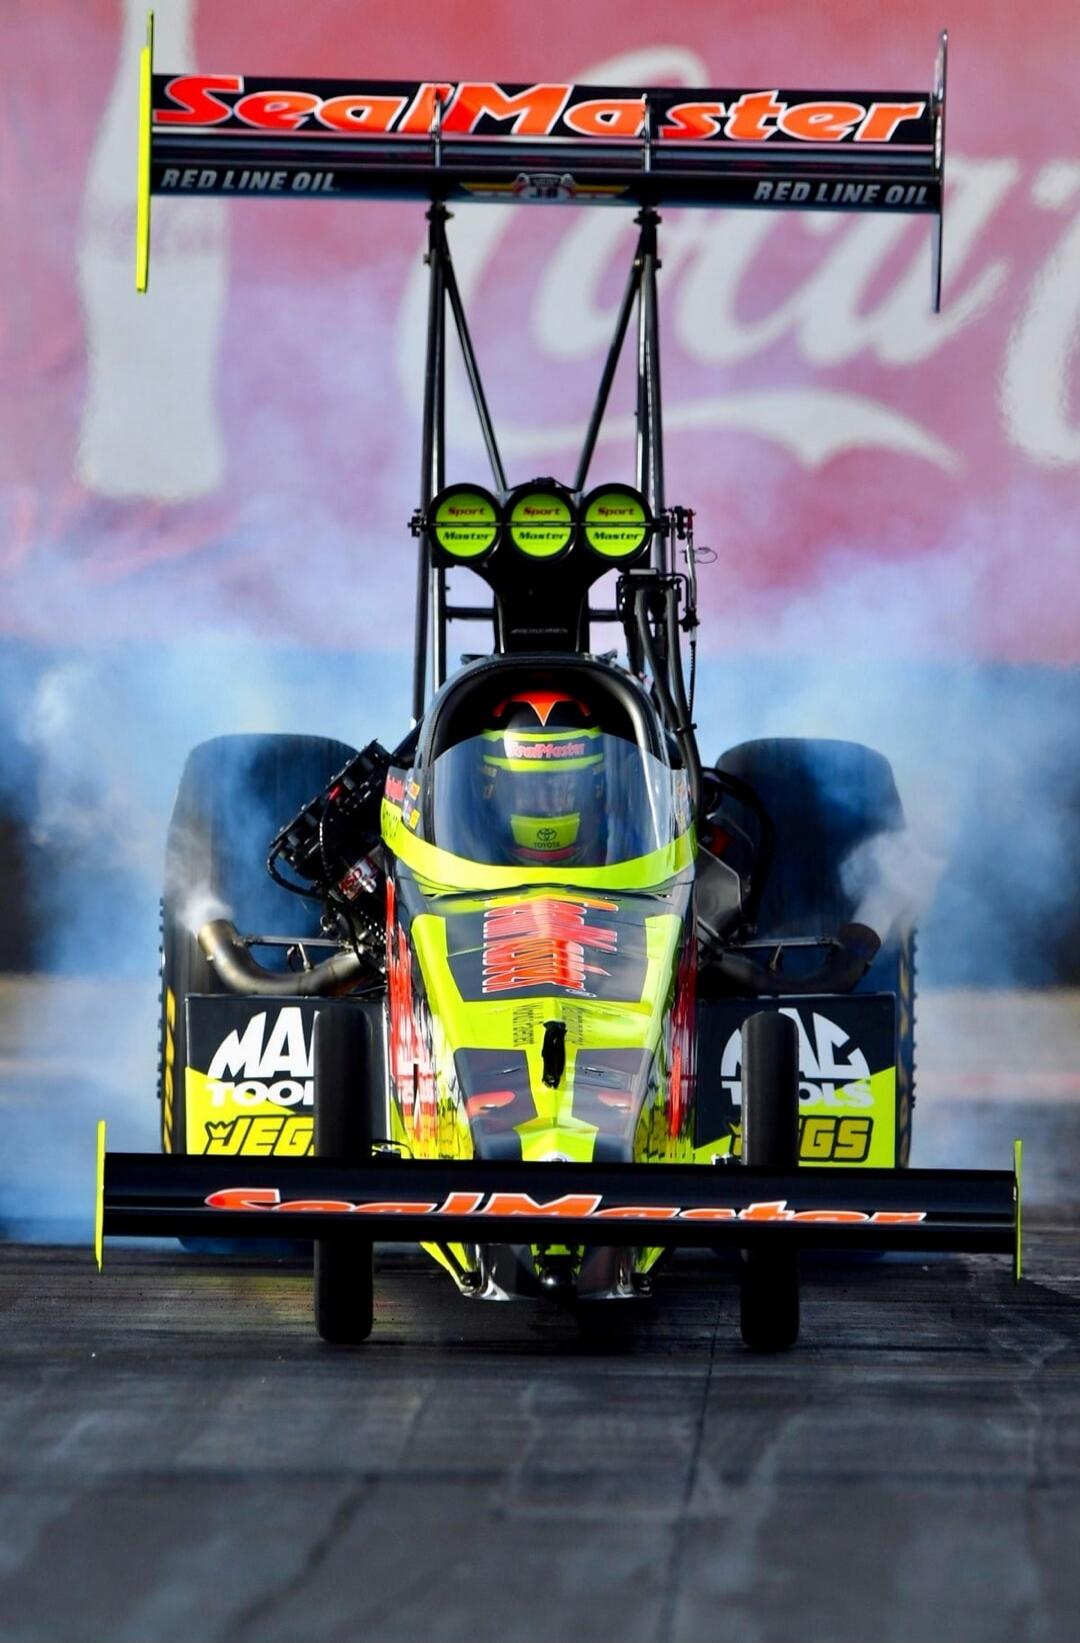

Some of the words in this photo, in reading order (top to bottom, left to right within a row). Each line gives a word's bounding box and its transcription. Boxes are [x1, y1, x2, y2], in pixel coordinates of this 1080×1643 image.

[153, 75, 926, 142] SealMaster
[160, 169, 218, 188] RED
[221, 171, 288, 190] LINE
[291, 173, 336, 192] OIL
[753, 181, 811, 201] RED
[814, 183, 881, 203] LINE
[884, 185, 928, 205] OIL
[448, 507, 485, 517] Sport
[523, 507, 561, 517] Sport
[597, 507, 635, 517] Sport
[442, 531, 491, 541] Master
[518, 531, 567, 541] Master
[592, 531, 641, 541] Master
[207, 1006, 315, 1079] MA
[721, 1080, 874, 1108] TOLS
[204, 1115, 315, 1157] JEG
